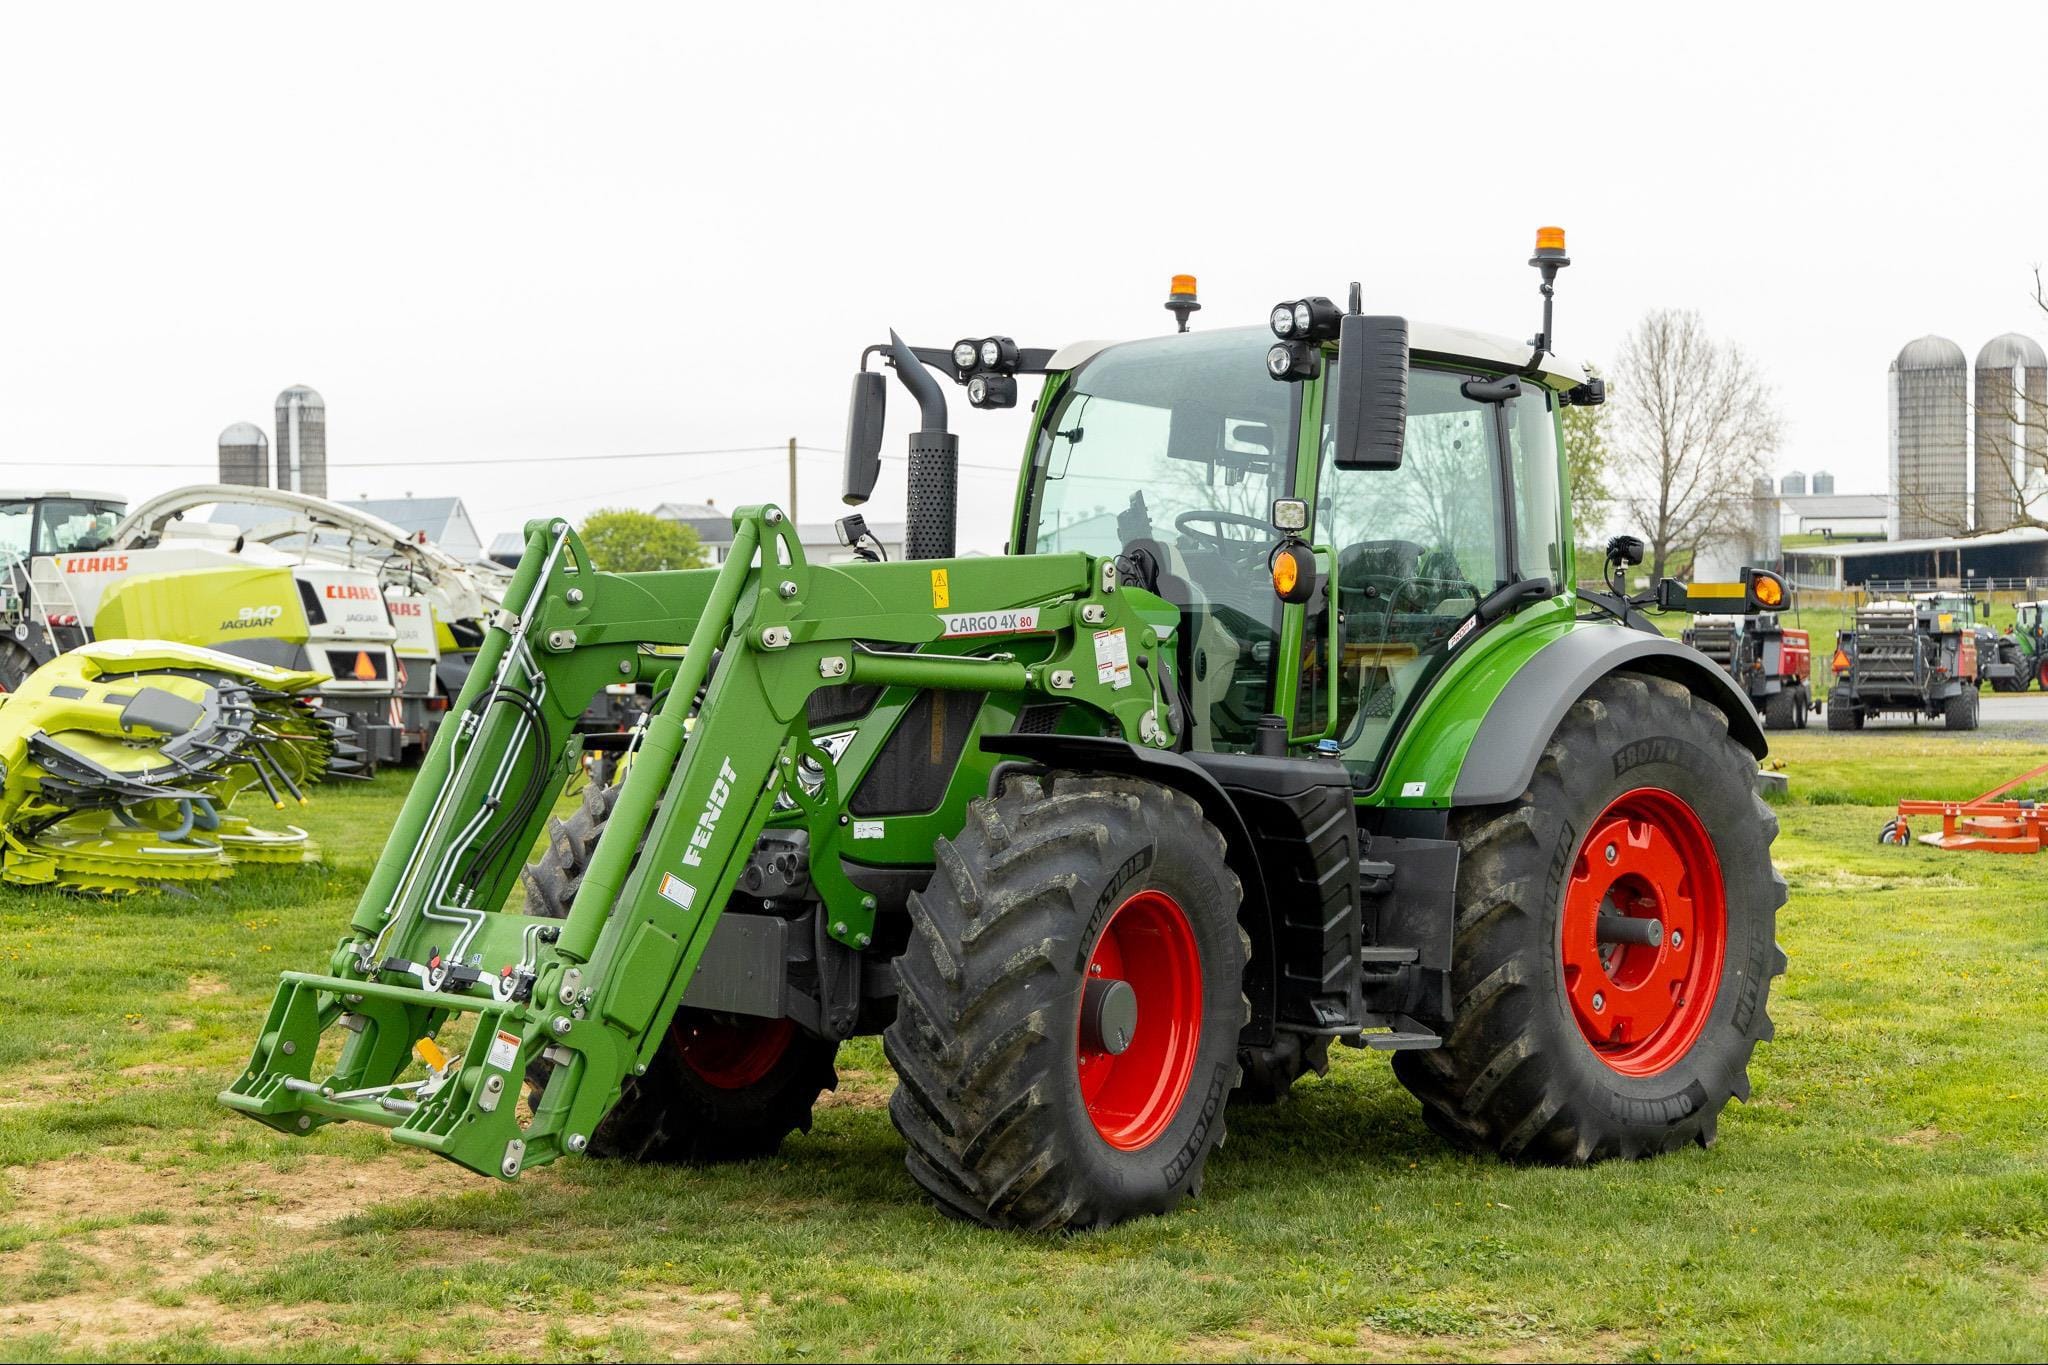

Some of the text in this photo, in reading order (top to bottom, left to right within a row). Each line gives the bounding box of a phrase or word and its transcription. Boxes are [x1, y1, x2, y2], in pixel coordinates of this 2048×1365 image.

[66, 556, 129, 574] CLAAS
[326, 585, 378, 600] CLAAS
[239, 605, 282, 621] 940
[388, 603, 421, 616] AAS
[220, 617, 275, 631] JAGUAR
[345, 613, 379, 623] JAGUAR
[949, 614, 1032, 633] CARGO 4X 80
[682, 755, 737, 867] FENDT
